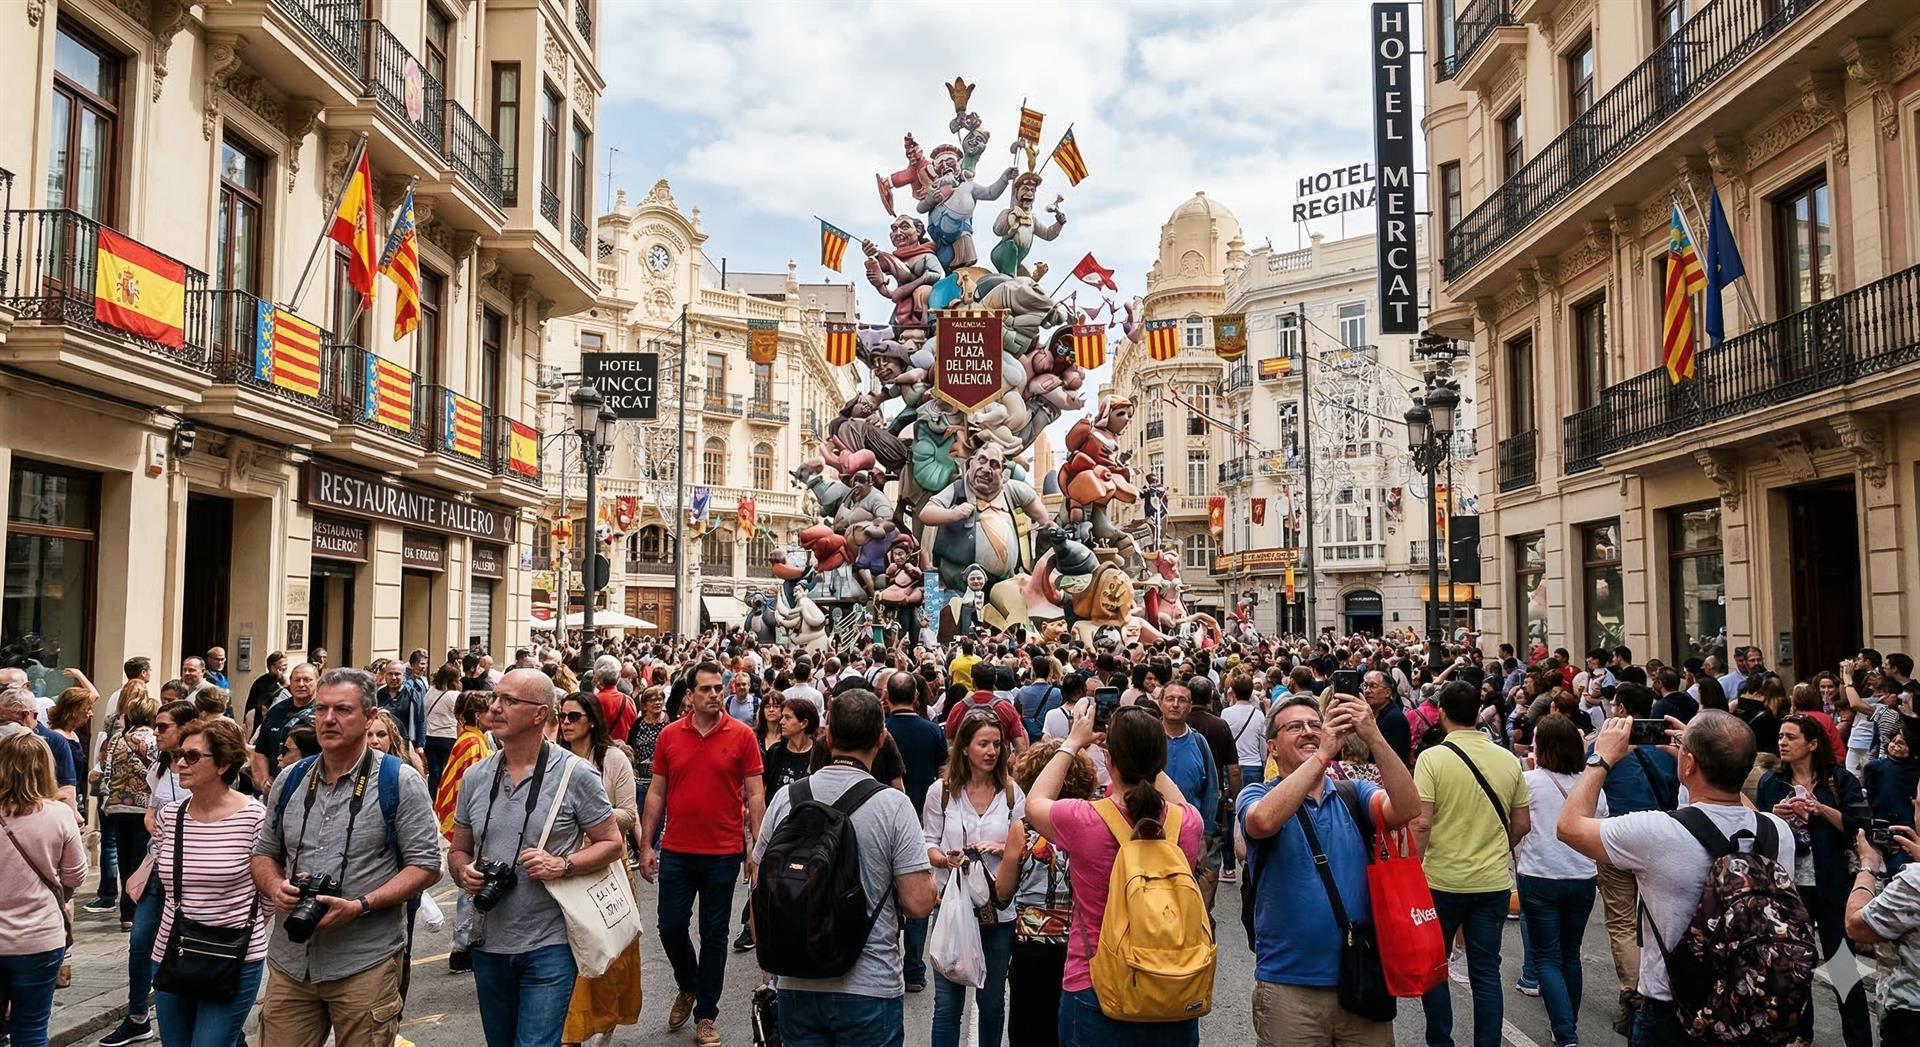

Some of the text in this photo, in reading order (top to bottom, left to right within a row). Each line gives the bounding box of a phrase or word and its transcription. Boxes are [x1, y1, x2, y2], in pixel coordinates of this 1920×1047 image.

[1380, 11, 1410, 323] HOTEL MERCAT
[1299, 162, 1377, 198] HOTEL
[955, 332, 985, 344] FALLA
[954, 346, 985, 358] PLAZA
[599, 360, 643, 371] HOTEL
[946, 359, 993, 371] DEL PILAR
[947, 373, 993, 385] VALENCIA
[604, 395, 652, 409] ERCAT
[320, 471, 494, 535] RESTAURANTE FALLERO
[313, 521, 363, 540] RESTAURANTE
